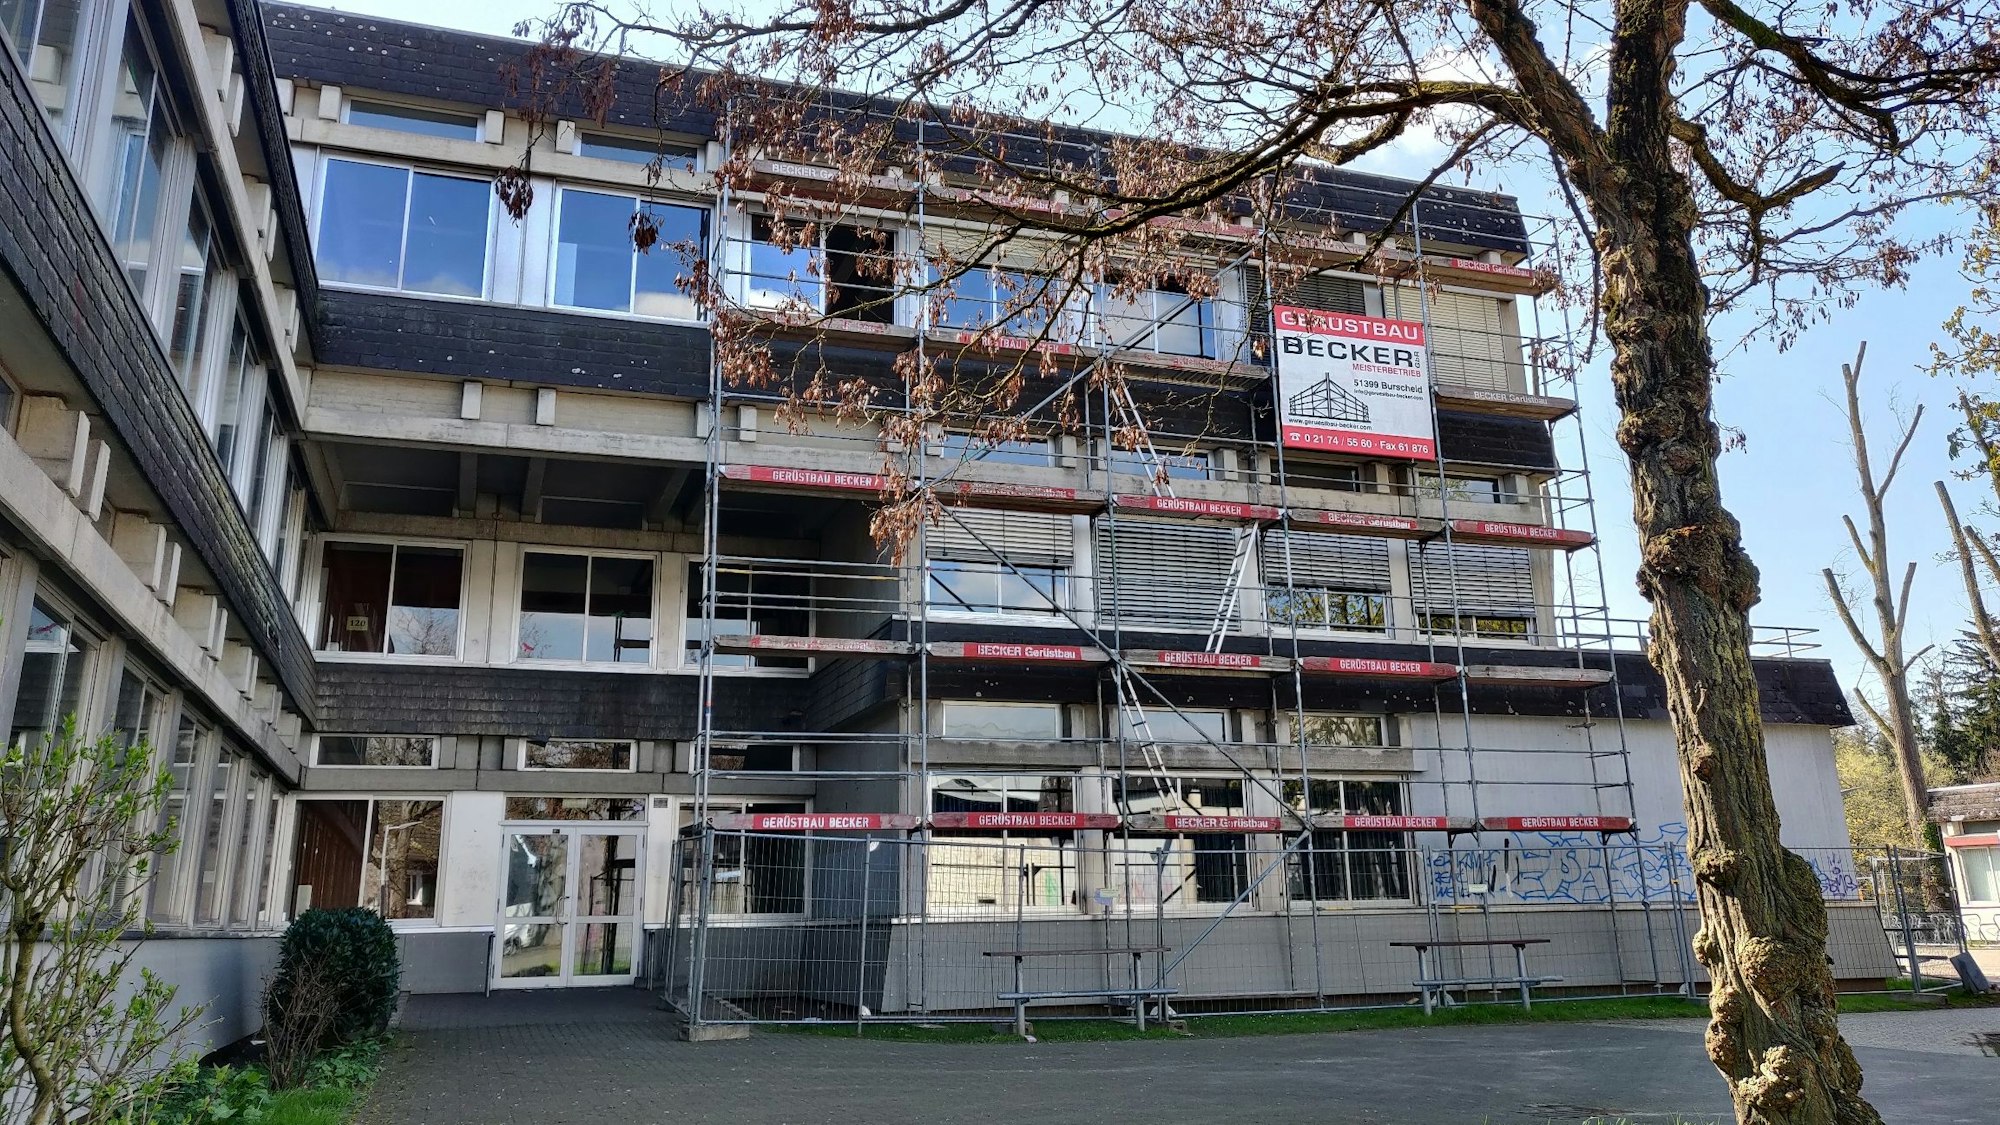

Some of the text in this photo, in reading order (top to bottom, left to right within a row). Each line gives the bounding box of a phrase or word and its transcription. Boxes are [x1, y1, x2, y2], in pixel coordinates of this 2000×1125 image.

[772, 163, 817, 177] BECKER
[1457, 259, 1530, 277] BECKER Gerüstbau
[1283, 336, 1413, 368] BECKER
[1352, 363, 1421, 377] MEISTERBETRIEB
[1353, 379, 1423, 394] 51399 Burscheid
[1474, 391, 1548, 405] BECKER Gerüstbau
[1288, 418, 1373, 431] www.geruestbau-becker.com
[1304, 433, 1311, 443] 0
[1313, 434, 1324, 444] 21
[1327, 435, 1339, 445] 74
[1347, 437, 1359, 447] 55
[1360, 438, 1373, 448] 60
[1380, 441, 1397, 451] Fax
[1398, 442, 1409, 452] 61
[1412, 443, 1429, 454] 876
[772, 470, 872, 487] GERÜSTBAU BECKER
[1157, 498, 1242, 516] GERÜSTBAU BECKER
[1484, 523, 1558, 538] GERÜSTBAU BECKER
[977, 644, 1075, 659] BECKER Gerüstbau
[1164, 651, 1252, 666] GERÜSTBAU BECKER
[1339, 659, 1421, 673] GERÜSTBAU BECKER
[762, 815, 869, 828] GERÜSTBAU BECKER
[978, 813, 1076, 826] GERÜSTBAU BECKER
[1175, 817, 1269, 829] BECKER Gerüstbau
[1354, 816, 1437, 828] GERÜSTBAU BECKER
[1521, 816, 1599, 828] GERÜSTBAU BECKER
